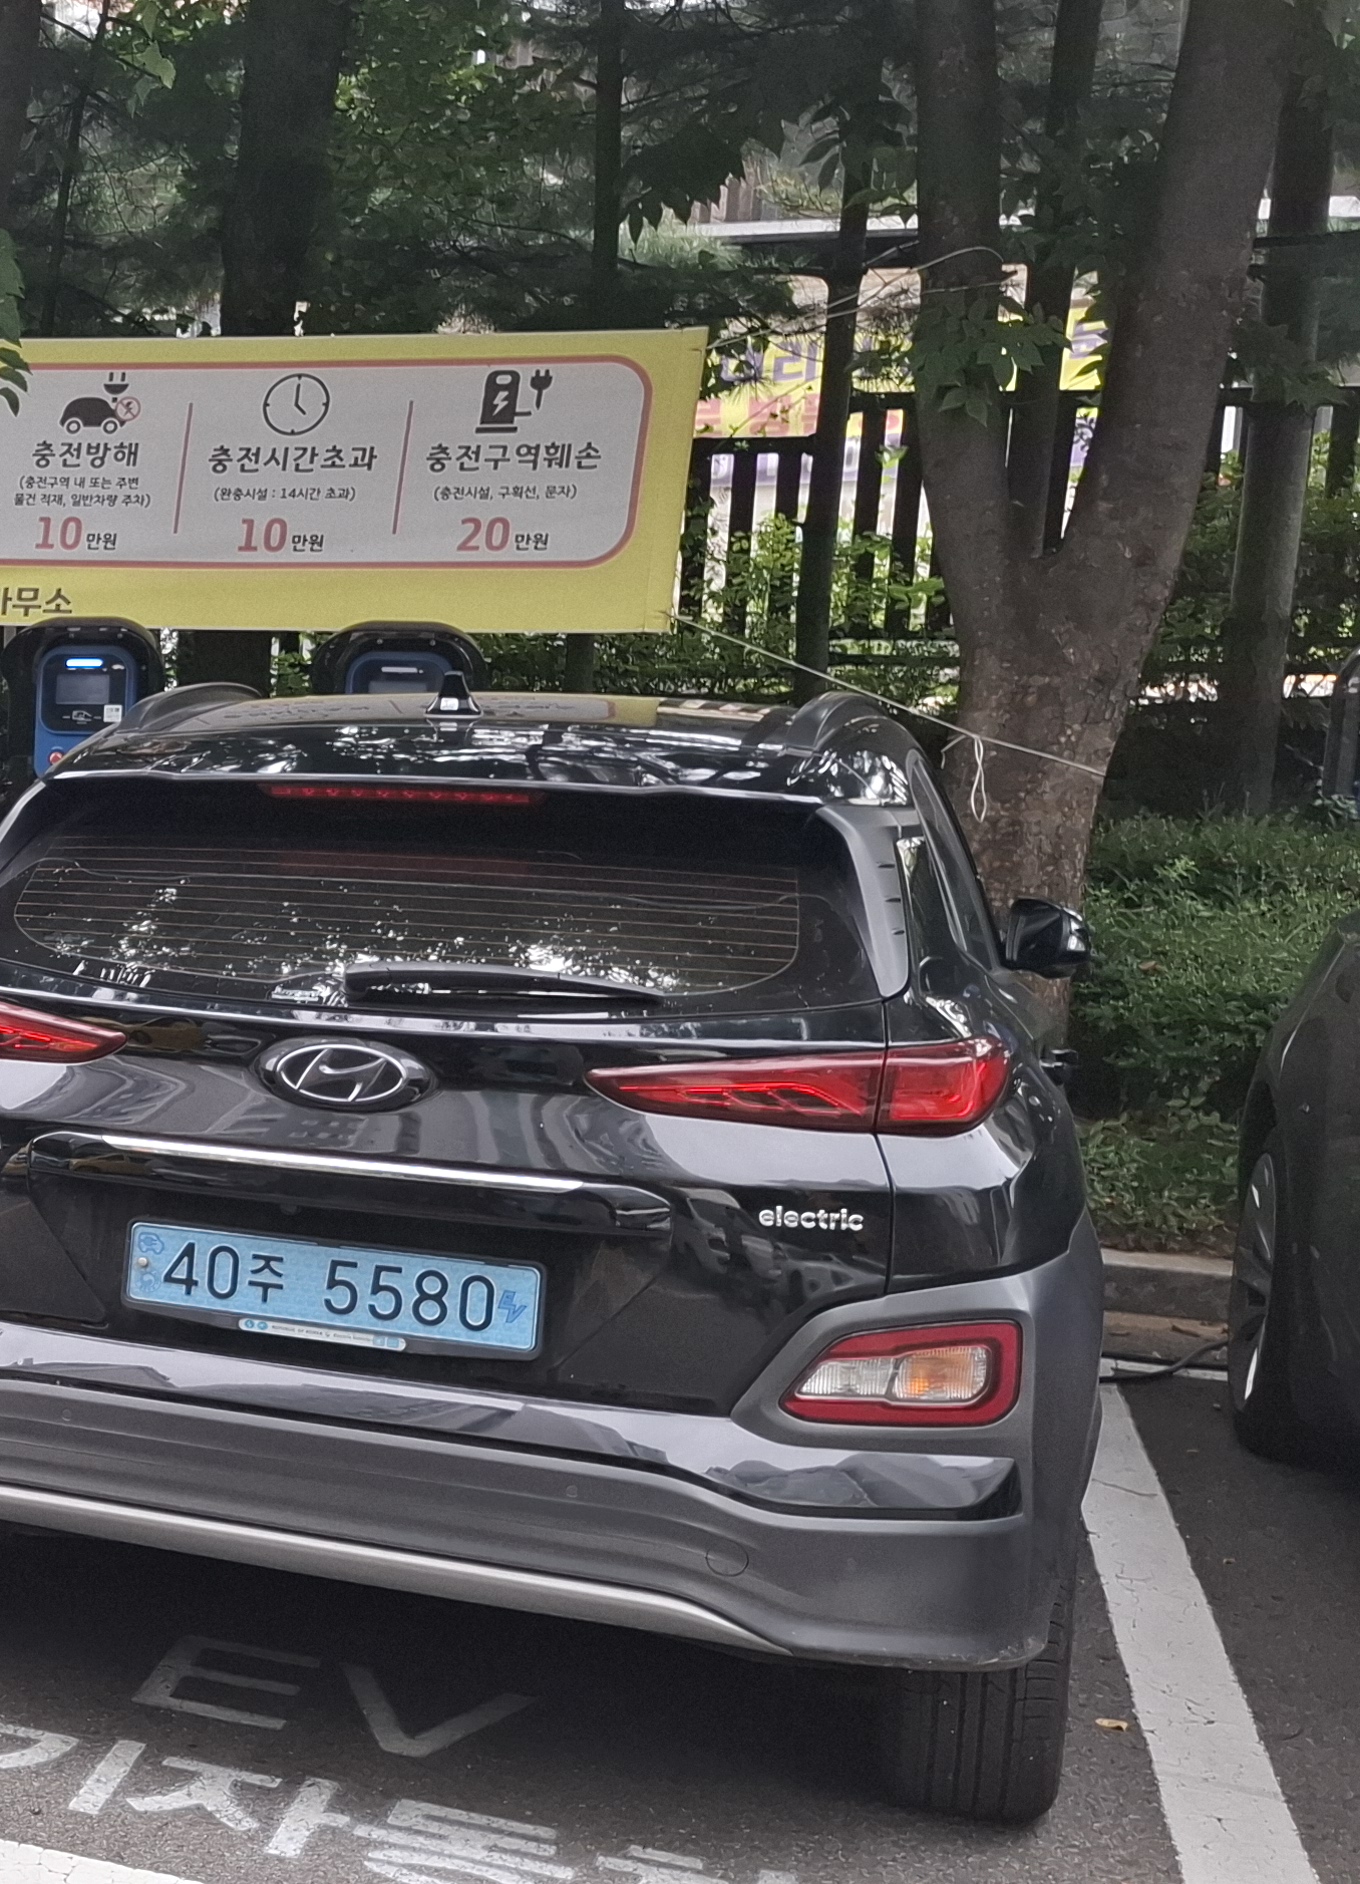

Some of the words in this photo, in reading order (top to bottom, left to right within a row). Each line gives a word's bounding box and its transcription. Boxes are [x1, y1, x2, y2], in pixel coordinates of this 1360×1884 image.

[32, 440, 139, 469] 충전방해
[208, 444, 378, 474] 충전시간초과
[426, 441, 601, 473] 충전구역훼손
[19, 475, 70, 490] (충전구역
[73, 476, 86, 489] 내
[88, 476, 112, 490] 또는
[115, 476, 139, 490] 주변
[280, 487, 321, 501] 14시간
[325, 486, 356, 502] 초과)
[70, 493, 118, 508] 일반차량
[121, 493, 151, 508] 주차)
[34, 516, 83, 551] 10
[86, 533, 117, 551] 만원
[237, 517, 288, 552] 10
[291, 534, 324, 552] 만원
[457, 516, 510, 552] 20
[515, 532, 549, 551] 만원
[758, 1205, 864, 1231] electric
[162, 1240, 285, 1303] 40주
[323, 1259, 495, 1332] 5580
[131, 1634, 542, 1758] EV
